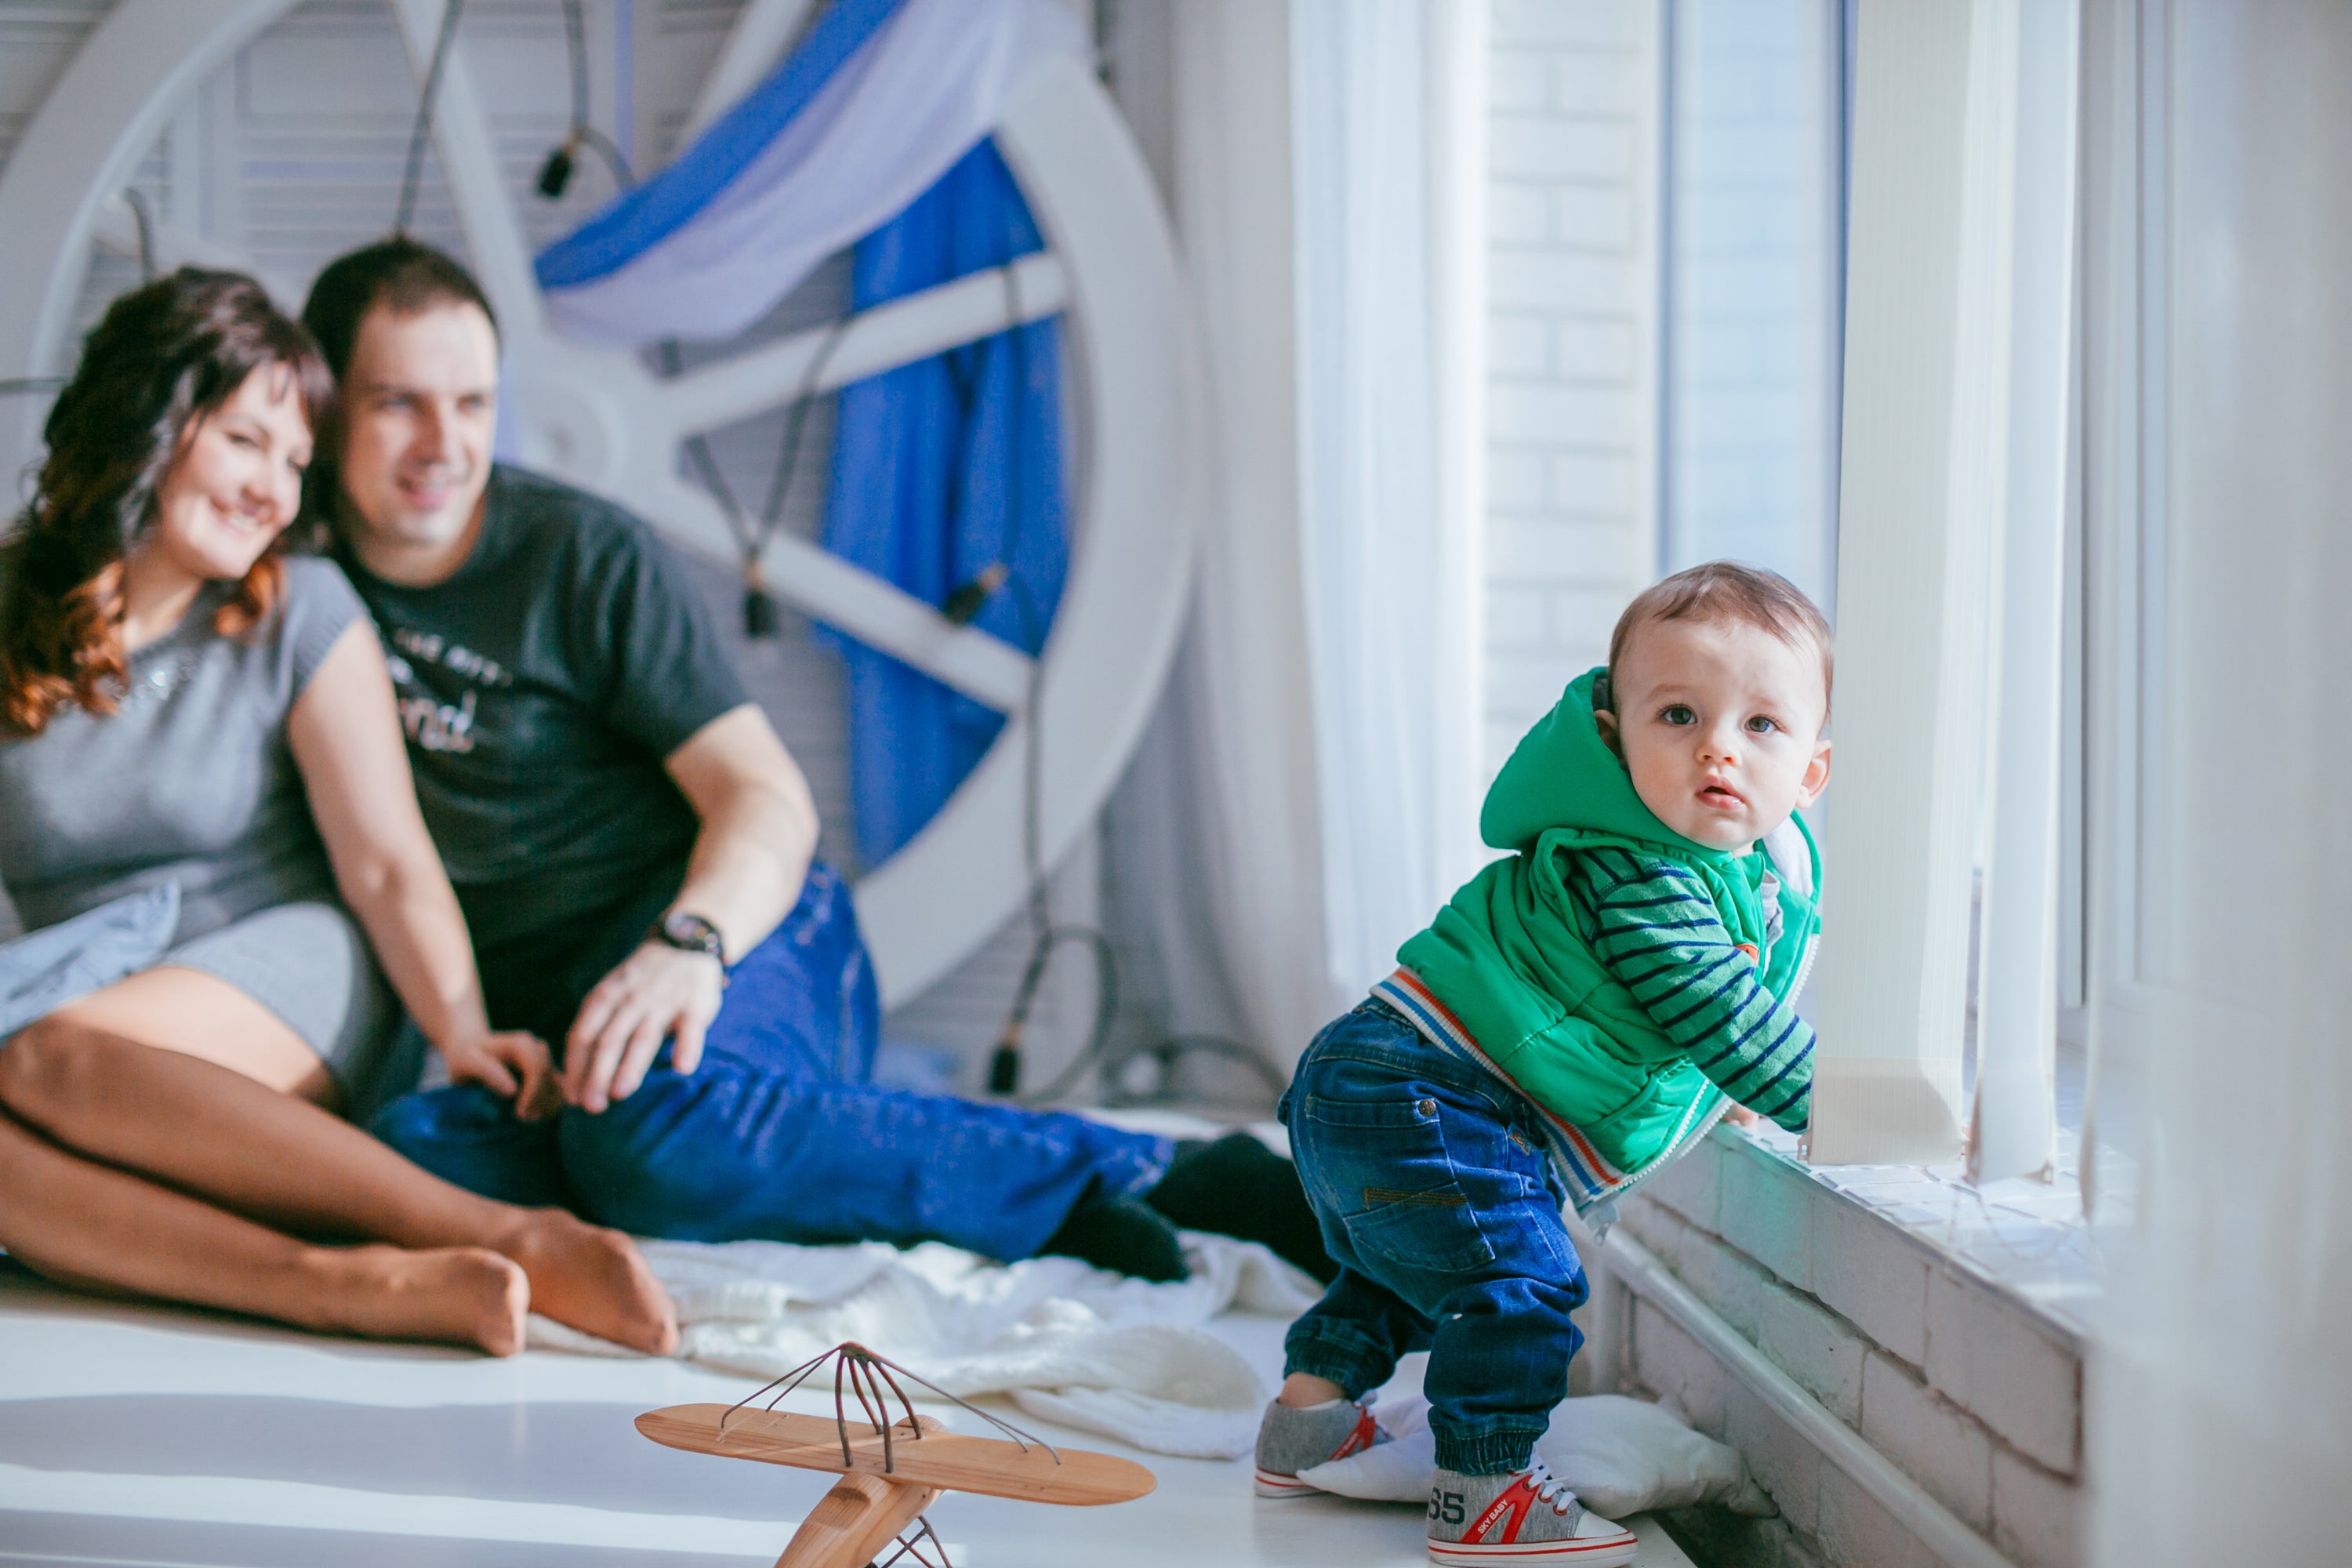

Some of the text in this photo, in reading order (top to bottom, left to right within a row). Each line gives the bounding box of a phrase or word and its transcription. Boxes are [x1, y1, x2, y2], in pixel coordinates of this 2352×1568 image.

[1428, 1486, 1465, 1524] 65
[1477, 1499, 1508, 1534] SKY BABY
